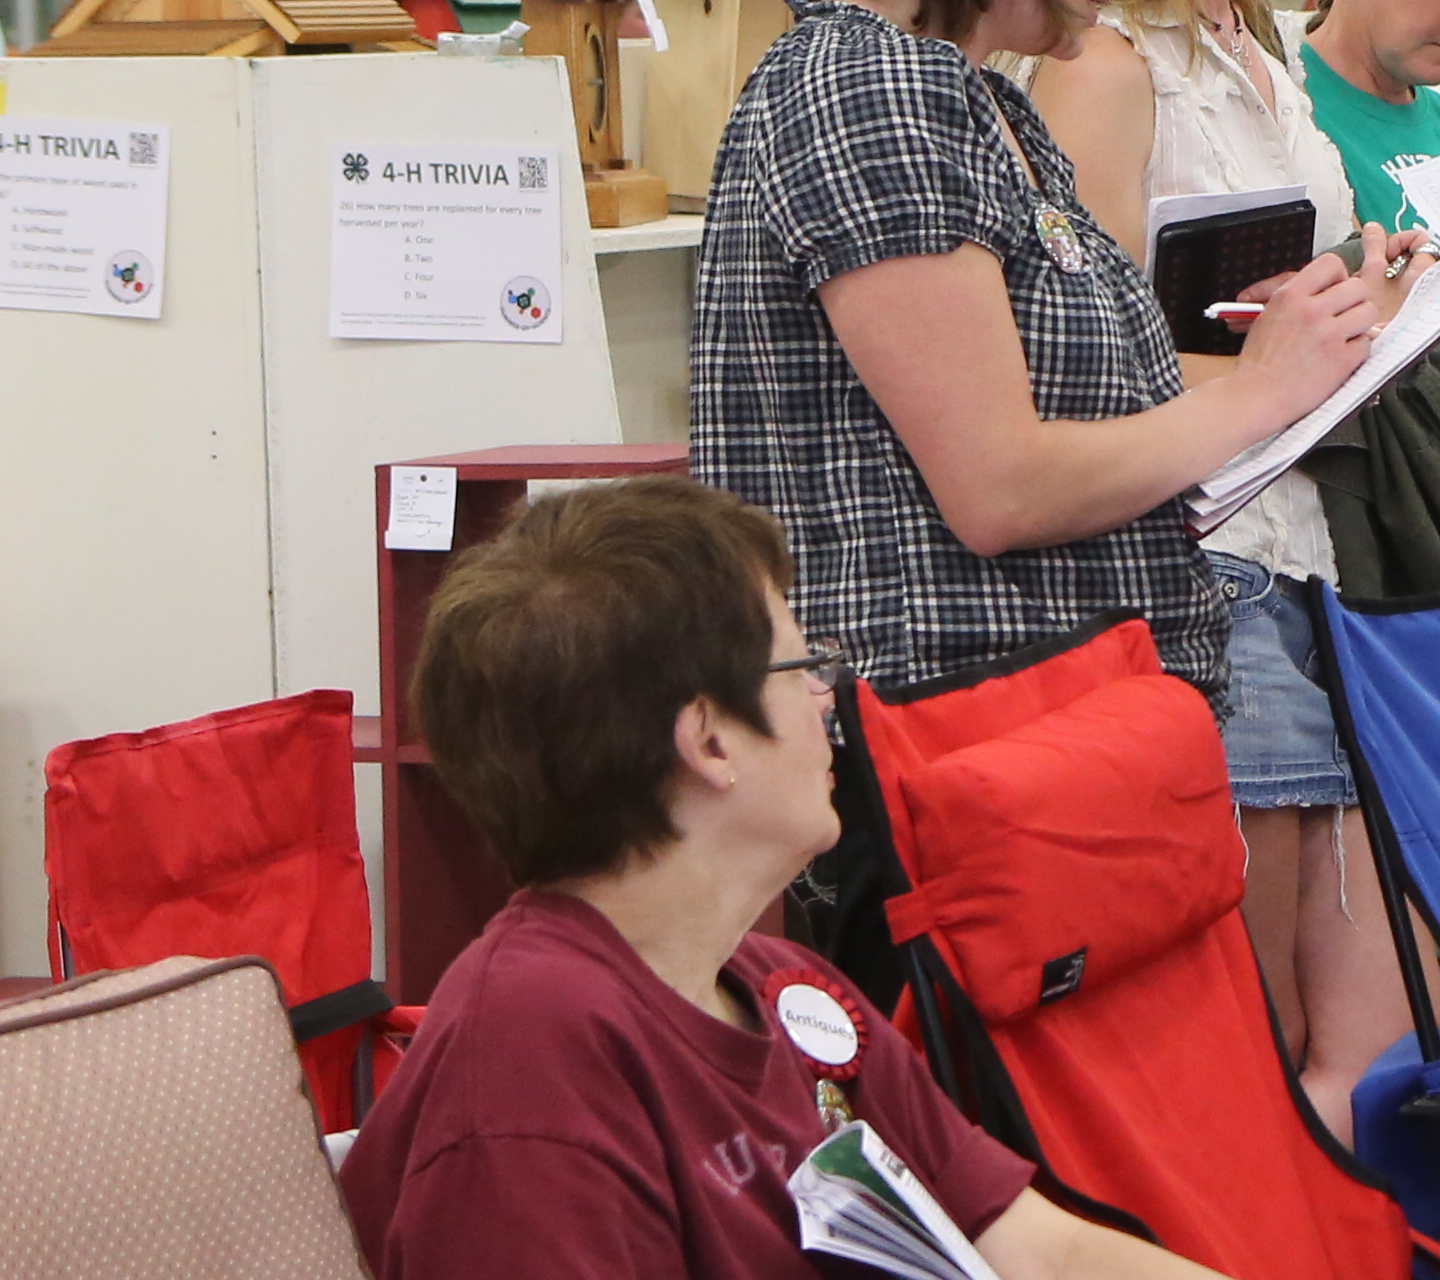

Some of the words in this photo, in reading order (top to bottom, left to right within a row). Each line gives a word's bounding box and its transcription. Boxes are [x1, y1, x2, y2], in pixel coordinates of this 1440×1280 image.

[38, 134, 121, 161] TRIVIA
[382, 161, 423, 184] 4-H
[429, 162, 511, 186] TRIVIA
[356, 201, 377, 212] How
[378, 203, 401, 214] many
[404, 202, 425, 213] trees
[427, 204, 441, 213] are
[442, 203, 484, 215] replanted
[485, 203, 498, 214] for
[499, 206, 523, 216] every
[525, 205, 543, 215] tree
[339, 217, 382, 228] harvested
[384, 220, 399, 229] per
[401, 219, 425, 229] year?
[415, 235, 434, 245] One
[415, 254, 434, 263] Two
[415, 272, 434, 281] Four
[415, 291, 429, 300] Six
[785, 1008, 856, 1041] Antiques
